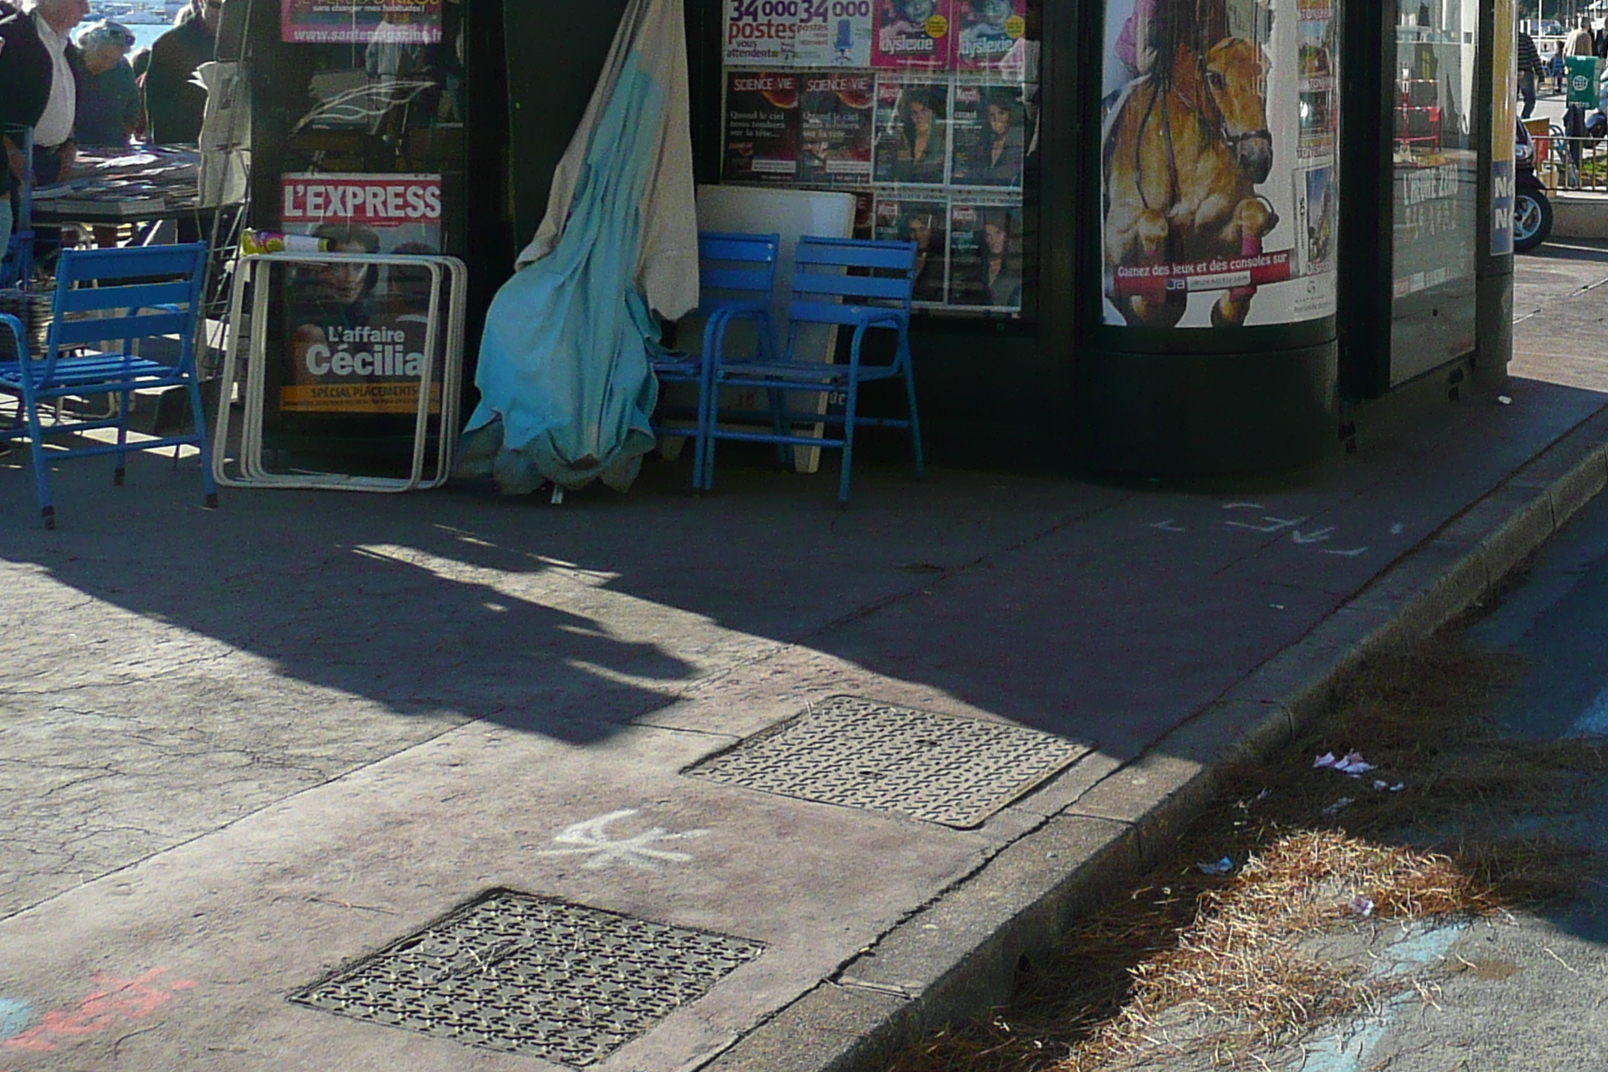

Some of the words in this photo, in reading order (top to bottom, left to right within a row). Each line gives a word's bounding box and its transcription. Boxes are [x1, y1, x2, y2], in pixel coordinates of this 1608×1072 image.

[761, 0, 798, 17] 000
[832, 0, 870, 17] 000
[728, 18, 797, 44] postes
[726, 48, 775, 59] attendent
[878, 34, 934, 55] dyslexie
[960, 36, 1014, 58] dyslexie
[733, 78, 774, 91] SCIENCE
[777, 77, 794, 90] VIE
[806, 79, 846, 92] SCIENCE
[851, 78, 868, 90] VIE
[283, 184, 442, 218] L'EXPRESS
[1118, 265, 1150, 278] Gagnez
[1152, 265, 1169, 276] des
[1172, 262, 1193, 275] jeux
[1196, 262, 1207, 273] et
[1209, 259, 1228, 272] des
[1229, 256, 1272, 270] consoles
[1273, 254, 1288, 264] sur
[327, 325, 406, 343] L'affaire
[305, 343, 425, 376] Cécilia
[352, 385, 418, 398] PLACEMENTS
